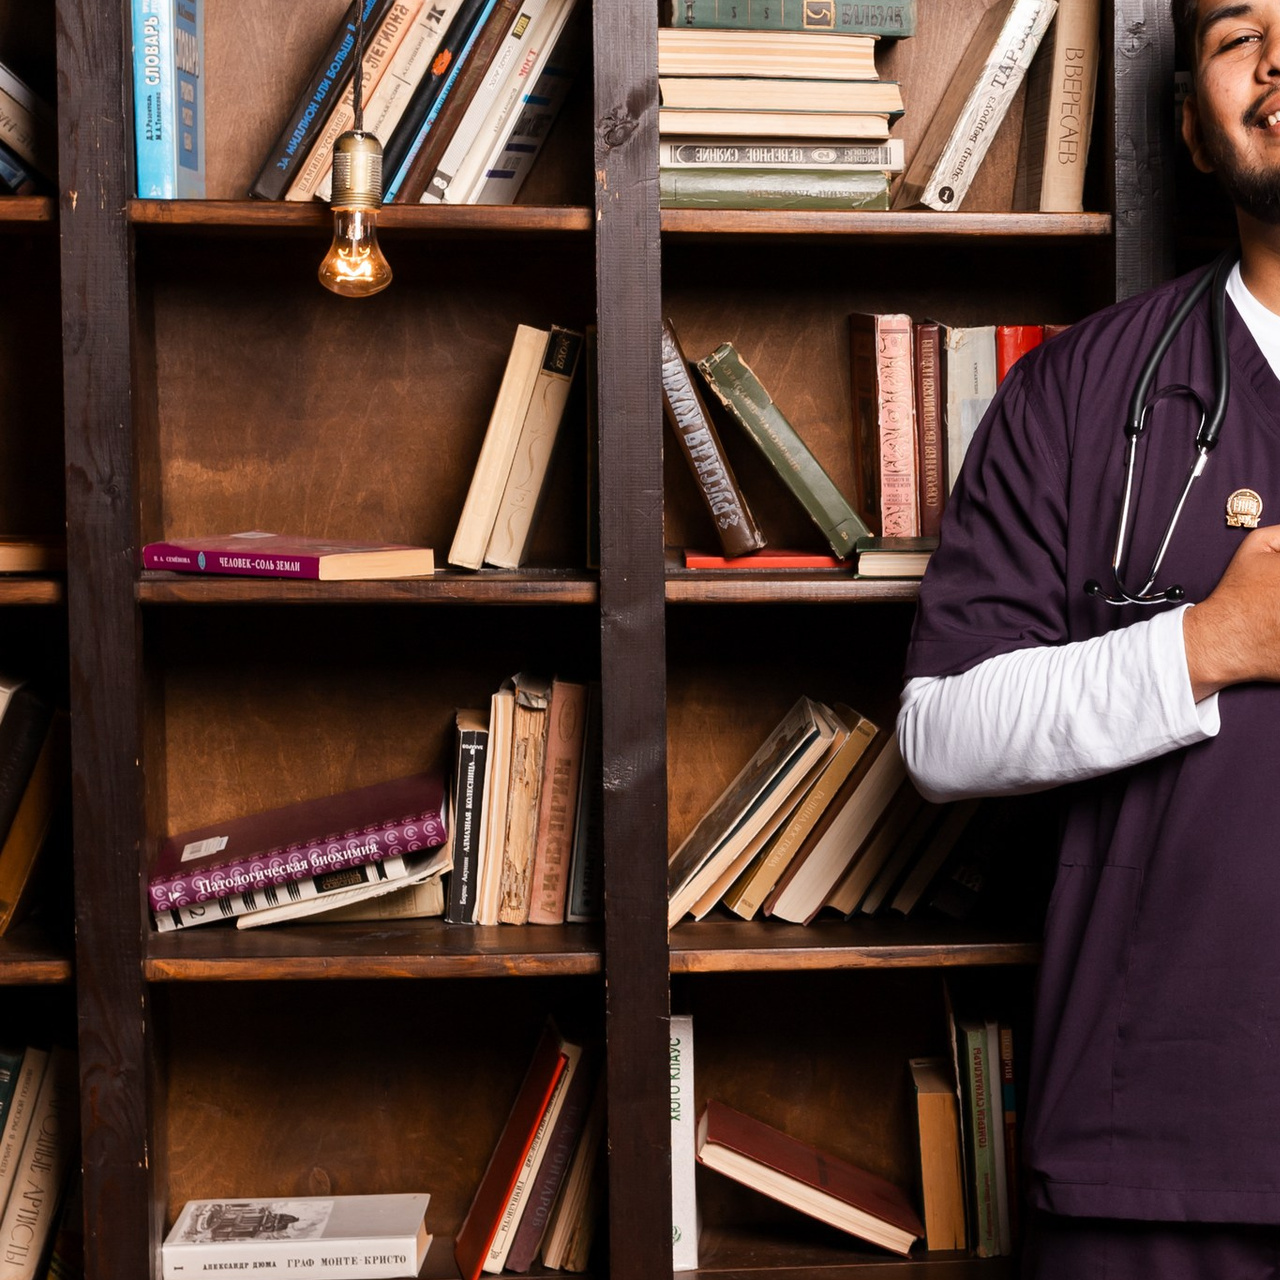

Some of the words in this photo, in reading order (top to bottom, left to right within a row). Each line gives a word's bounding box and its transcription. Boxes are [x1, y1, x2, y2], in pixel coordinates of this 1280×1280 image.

[839, 2, 904, 31] БАЛЬЗАК
[143, 15, 160, 85] СЛОВАРЬ
[362, 0, 412, 70] ЛЕГИОНА
[323, 31, 357, 79] БОЛЬШЕ
[517, 46, 539, 79] МОСТ
[311, 76, 332, 102] ИЛИ
[1062, 47, 1086, 165] В.ВЕРЕСАЕВ
[282, 99, 319, 156] МИЛЛИОН
[275, 153, 291, 171] ЗА
[298, 151, 326, 192] ШАМИЛЬ
[319, 109, 349, 152] УСМАНОВ
[694, 144, 738, 164] СИЯНИЕ
[744, 144, 803, 166] СЕВЕРНОЕ
[682, 426, 736, 517] РУССКАЯ
[274, 558, 300, 573] ЗЕМЛИ
[464, 761, 476, 808] КОЛЕСНИЦА
[797, 789, 825, 824] ГАЛИНА
[462, 811, 473, 852] АЛМАЗНАЯ
[198, 854, 309, 897] Патологическая
[310, 839, 380, 869] биохимия
[461, 856, 471, 882] Акунин
[459, 884, 468, 904] Борис
[669, 1036, 681, 1080] КЛАУС
[669, 1084, 680, 1120] ХЮГО
[530, 1142, 569, 1230] ГОНЧАРОВ
[203, 1262, 249, 1271] АЛЕКСАНДР
[252, 1261, 276, 1269] ДЮМА
[287, 1258, 315, 1269] ГРАФ
[321, 1254, 407, 1267] МОНТЕ-КРИСТО
